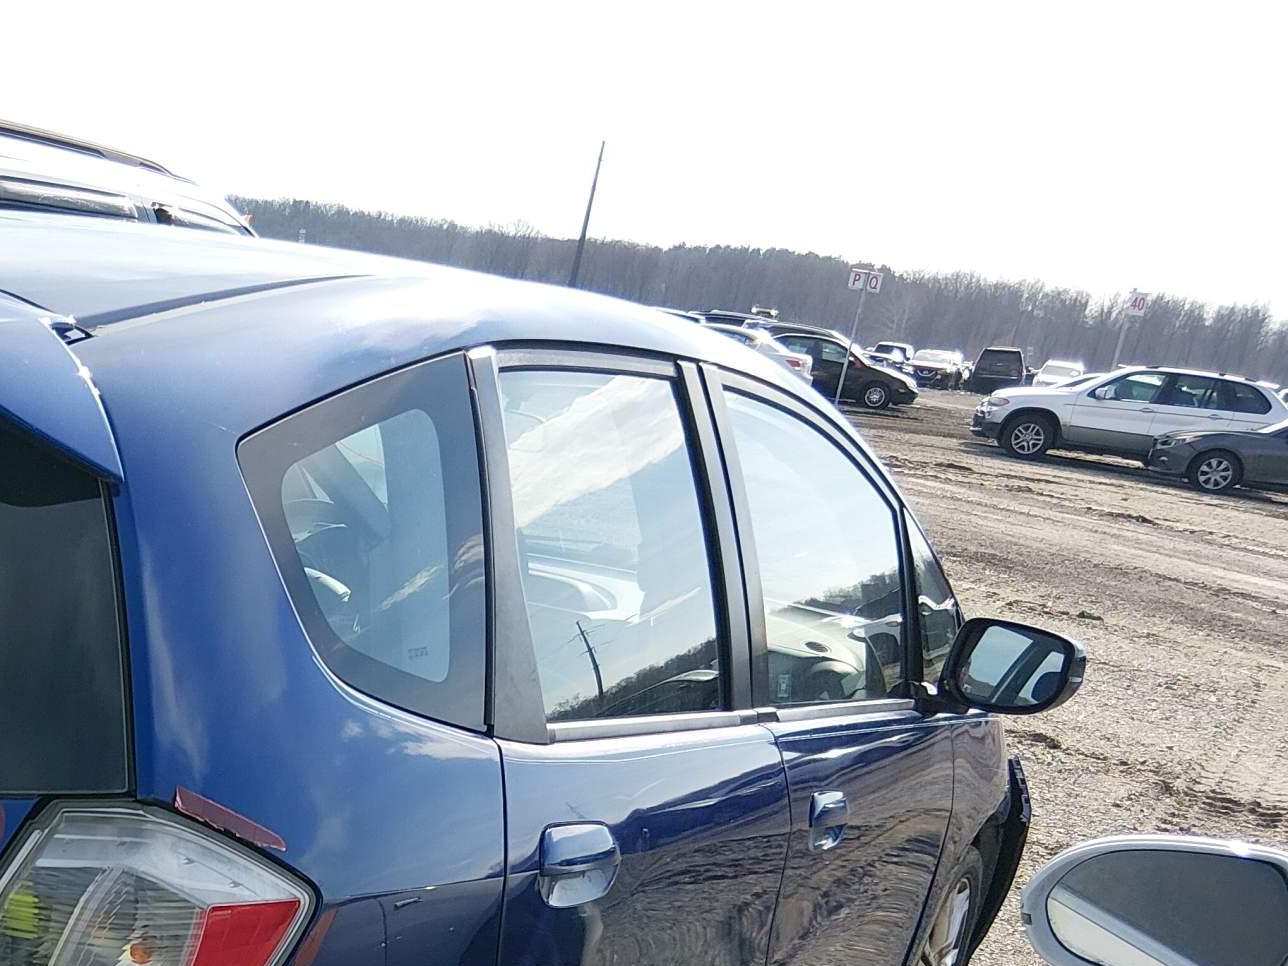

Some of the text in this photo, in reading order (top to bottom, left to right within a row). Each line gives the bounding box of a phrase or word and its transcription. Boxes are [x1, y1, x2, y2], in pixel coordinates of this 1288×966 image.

[852, 273, 879, 290] P Q
[1129, 296, 1145, 312] 40
